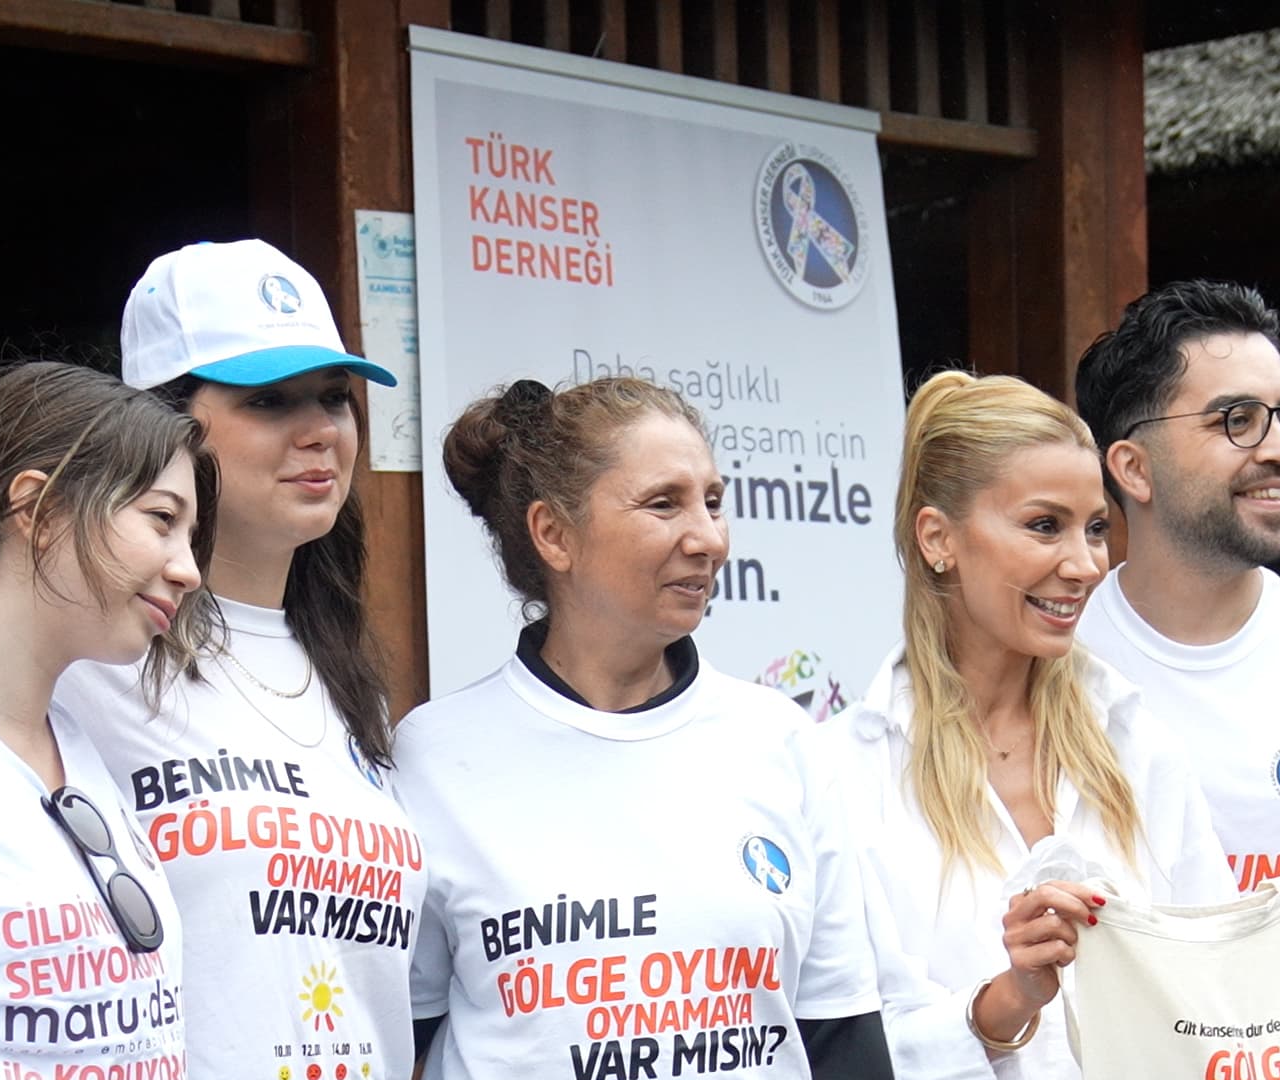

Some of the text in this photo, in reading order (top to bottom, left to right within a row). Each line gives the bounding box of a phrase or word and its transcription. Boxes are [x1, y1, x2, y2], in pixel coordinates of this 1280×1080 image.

[465, 131, 556, 186] TÜRK
[469, 184, 600, 237] KANSER
[472, 234, 613, 287] DERNEĞİ
[668, 359, 781, 410] sağlıklı
[815, 420, 866, 463] için
[131, 748, 310, 811] BENİMLE
[149, 799, 422, 871] GÖLGE OYUNU
[267, 852, 402, 903] OYNAMAYA
[249, 889, 415, 950] VAR MISIN
[481, 893, 657, 962] BENİMLE
[497, 946, 780, 1018] GÖLGE OYUNU
[586, 993, 753, 1040] OYNAMAYA
[1174, 1019, 1197, 1036] Cilt
[1246, 1024, 1263, 1038] dur
[672, 1025, 787, 1077] MISIN?
